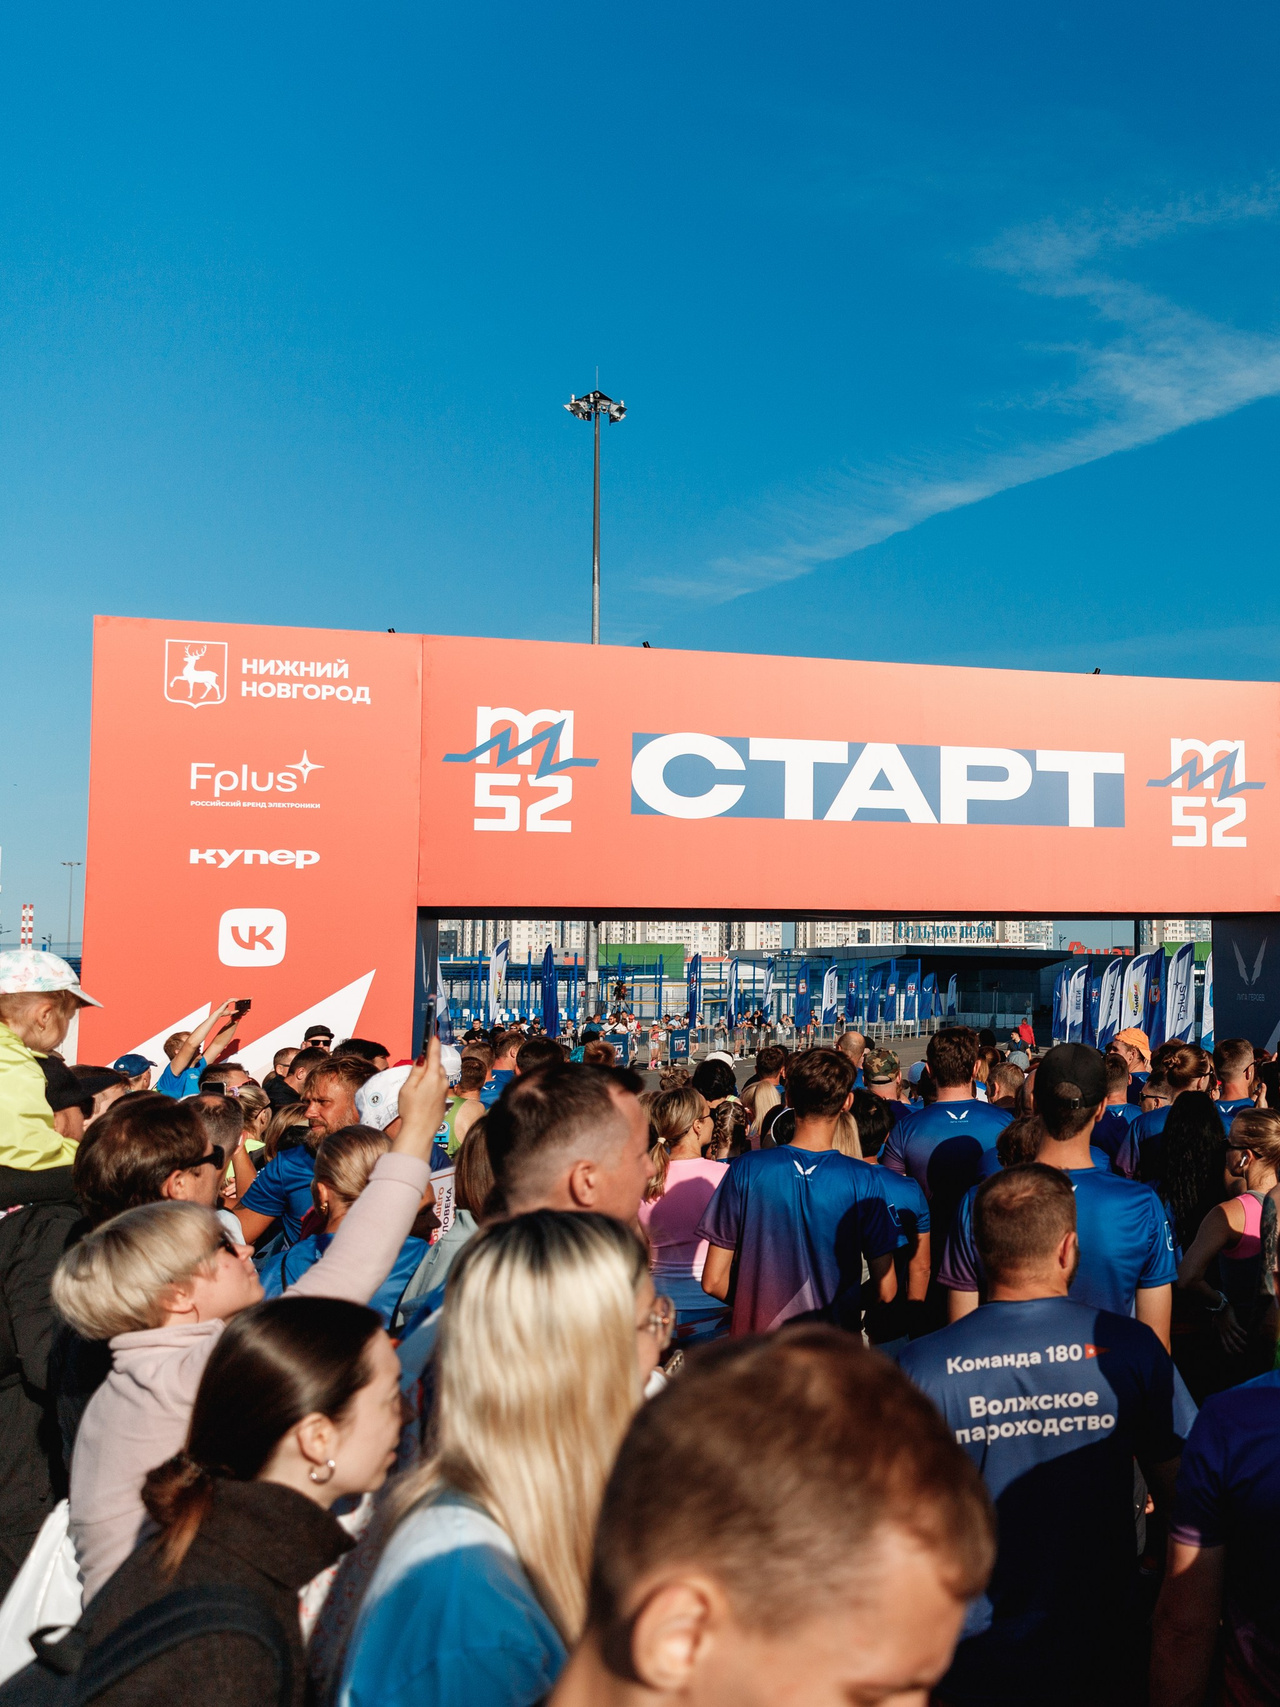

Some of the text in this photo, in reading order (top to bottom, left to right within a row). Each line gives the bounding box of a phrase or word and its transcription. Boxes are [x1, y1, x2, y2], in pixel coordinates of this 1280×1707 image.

[242, 658, 349, 679] НИЖНИЙ
[241, 681, 371, 705] НОВГОРОД
[190, 762, 298, 798] Fplus
[632, 733, 1125, 828] СТАРТ
[473, 773, 573, 832] 52
[1172, 796, 1247, 847] 52
[189, 848, 321, 869] купер
[231, 926, 275, 951] VK
[946, 1343, 1083, 1375] Команда 180
[968, 1390, 1099, 1418] Волжское
[955, 1413, 1116, 1445] пароходство
